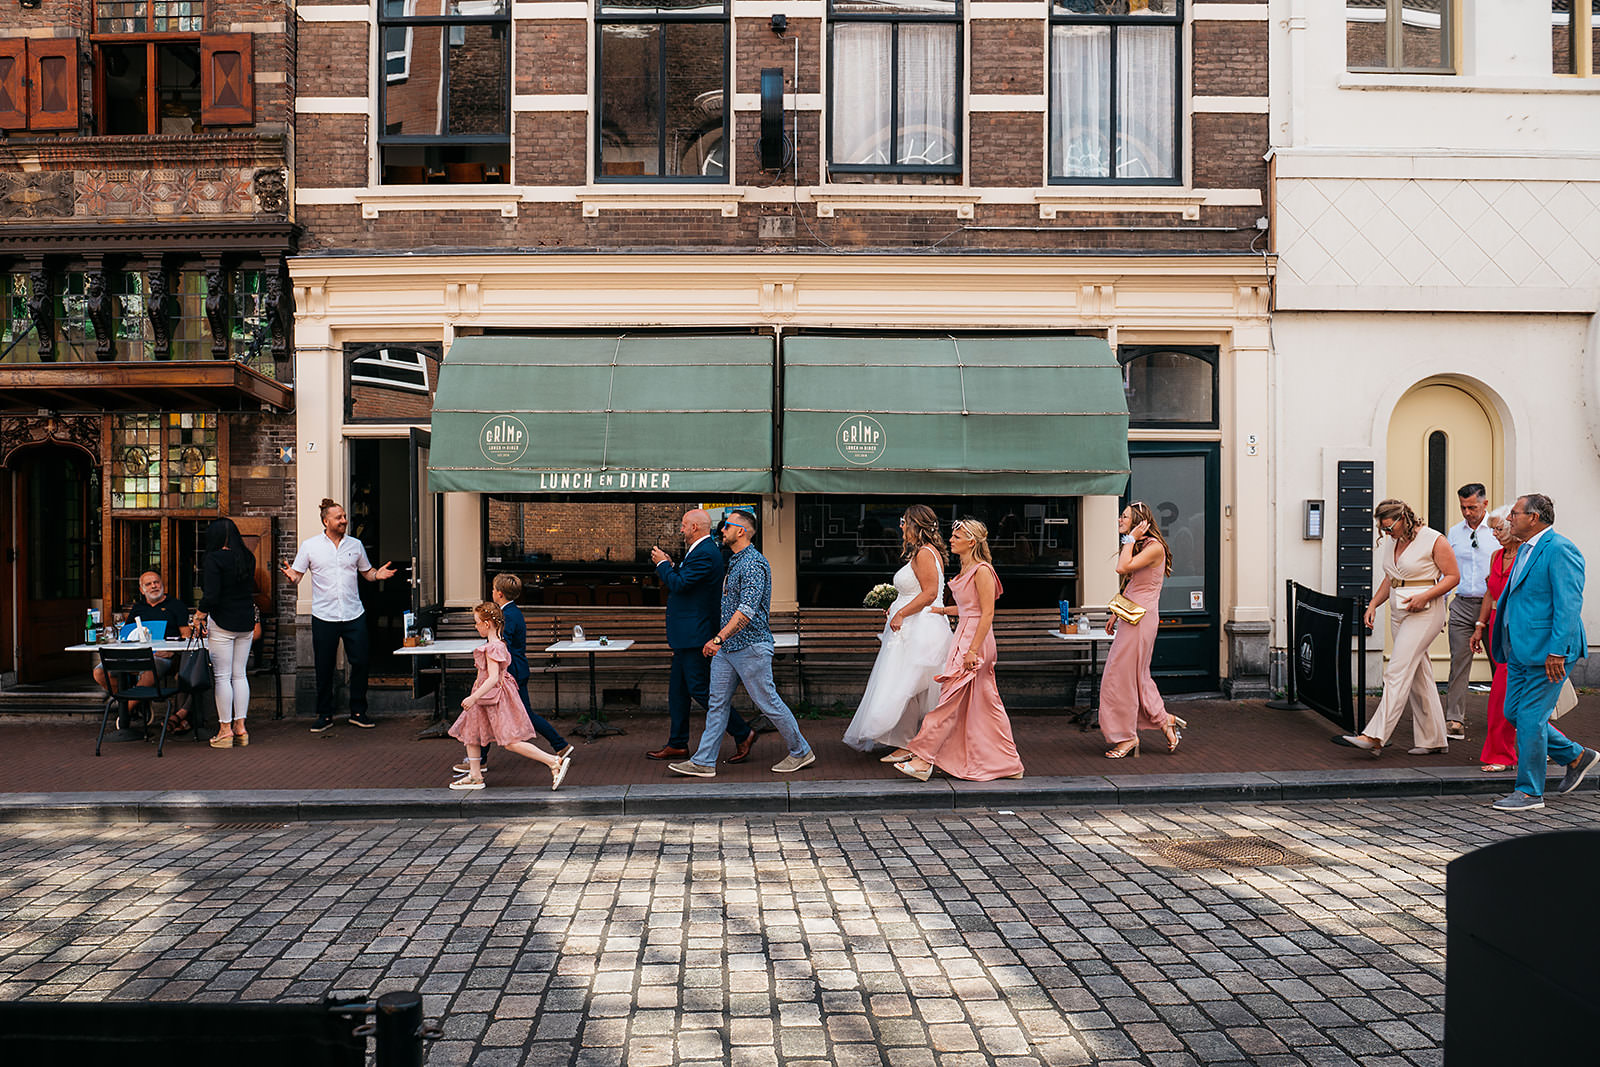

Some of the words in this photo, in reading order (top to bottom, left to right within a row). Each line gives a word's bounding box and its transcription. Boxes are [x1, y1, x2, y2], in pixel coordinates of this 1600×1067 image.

[540, 473, 593, 489] LUNCH
[599, 474, 613, 486] EN
[620, 472, 670, 488] DINER
